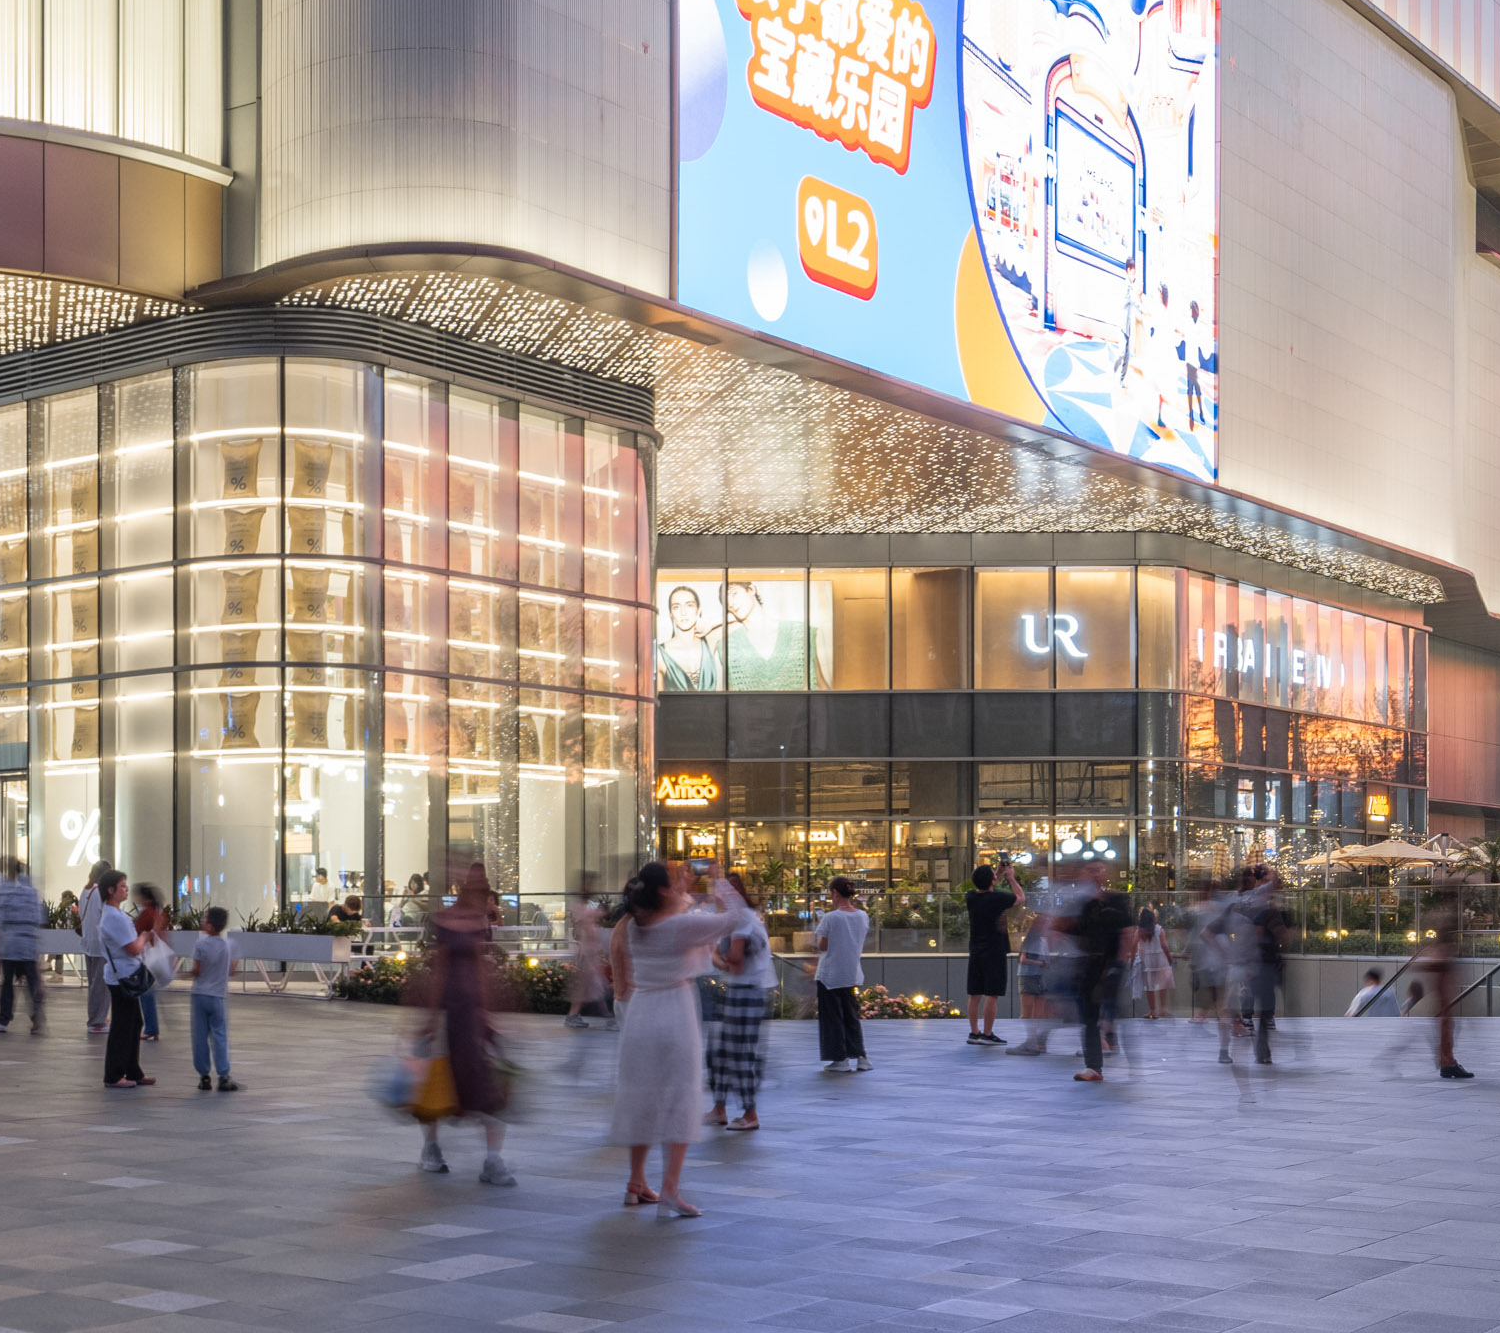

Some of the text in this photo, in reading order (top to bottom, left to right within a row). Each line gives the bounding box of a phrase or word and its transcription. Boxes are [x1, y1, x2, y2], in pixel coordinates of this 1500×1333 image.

[753, 15, 908, 155] 宝藏乐园
[825, 198, 871, 272] L2
[1019, 613, 1088, 658] UR
